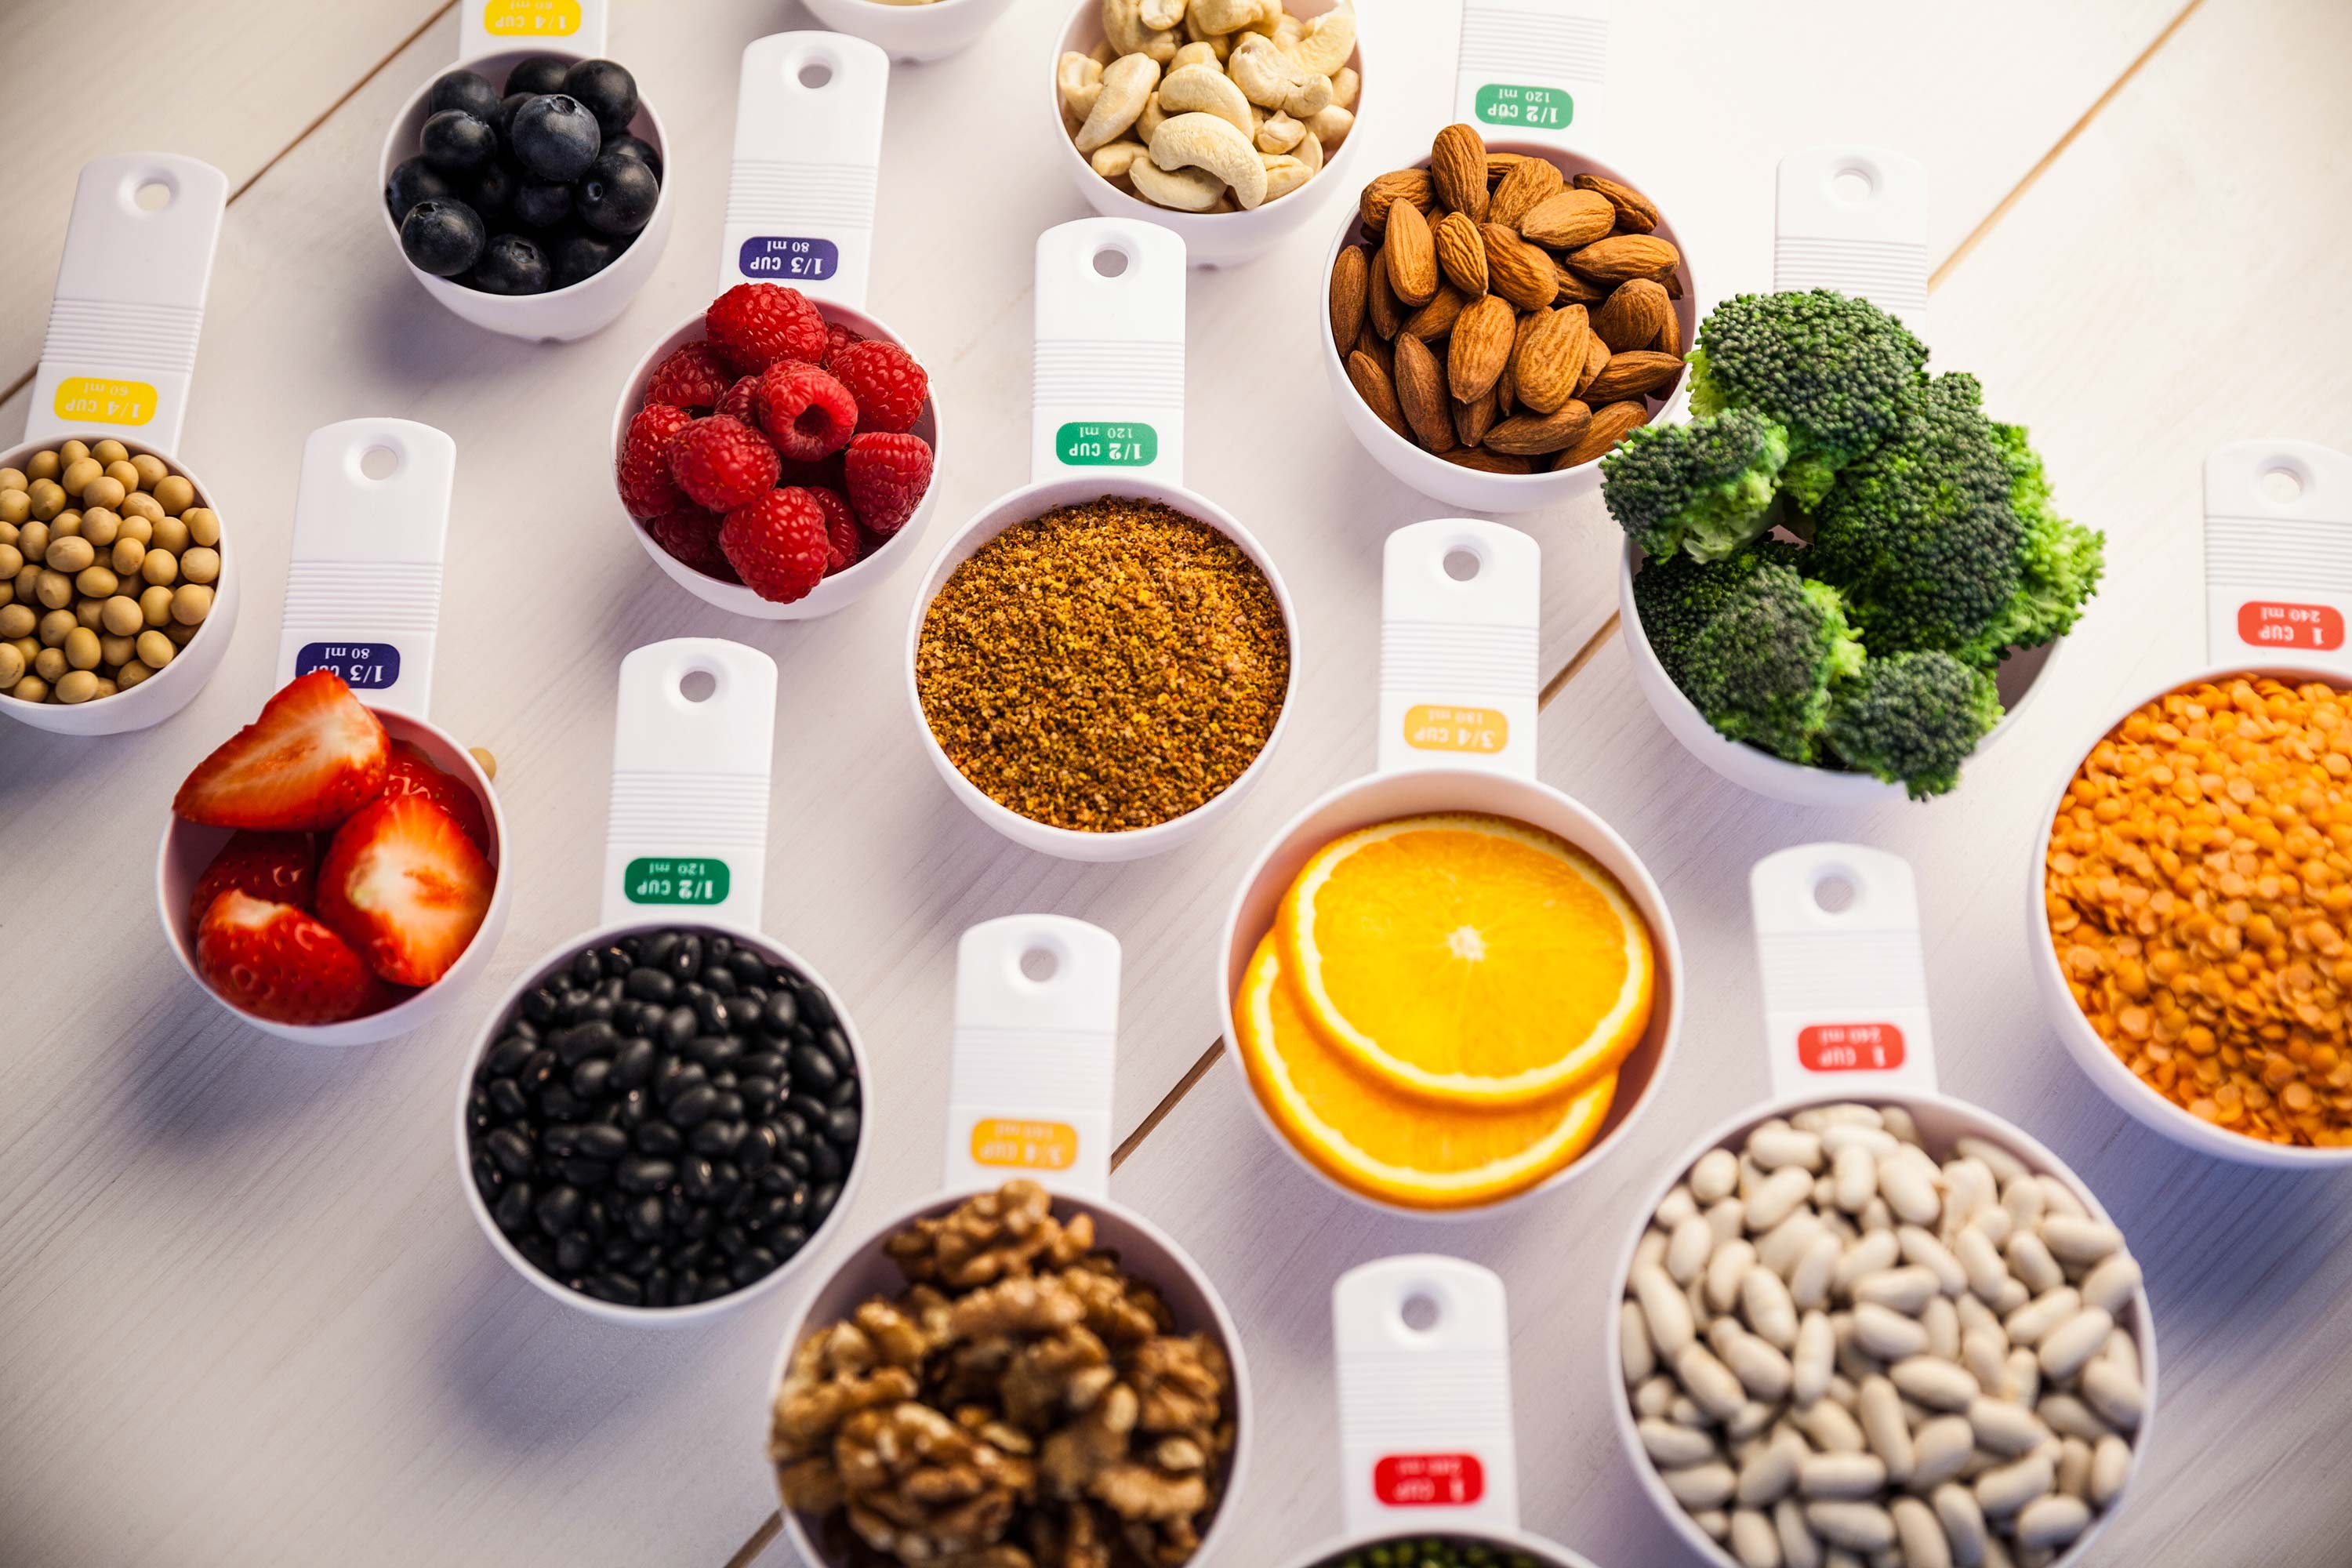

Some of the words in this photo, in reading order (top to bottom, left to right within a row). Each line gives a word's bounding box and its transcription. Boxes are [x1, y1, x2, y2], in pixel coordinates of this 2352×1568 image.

[495, 16, 525, 28] CUP
[535, 16, 566, 30] 1/4
[1498, 89, 1518, 100] ml
[1525, 91, 1550, 103] 120
[1487, 103, 1519, 118] CUP
[1526, 105, 1558, 123] 1/2
[767, 241, 787, 252] ml
[792, 241, 810, 253] 80
[750, 256, 782, 270] CUP
[791, 256, 823, 275] 1/3
[84, 382, 105, 394] ml
[111, 385, 129, 396] 60
[65, 398, 98, 413] CUP
[107, 401, 141, 419] 1/4
[1080, 426, 1099, 438] ml
[1107, 427, 1132, 438] 120
[1069, 443, 1101, 456] CUP
[1109, 443, 1142, 460] 1/2
[2260, 606, 2285, 621] ml
[2288, 608, 2321, 623] 240
[2258, 625, 2294, 641] CUP
[2312, 627, 2325, 646] 1
[325, 648, 347, 659] ml
[351, 648, 370, 659] 80
[350, 665, 384, 683] 1/3
[1414, 726, 1449, 743] CUP
[1457, 727, 1496, 749] 3/4
[649, 862, 670, 876] ml
[677, 862, 705, 876] 120
[637, 879, 671, 895] CUP
[678, 880, 714, 899] 1/2
[1817, 1044, 1857, 1067] CUP
